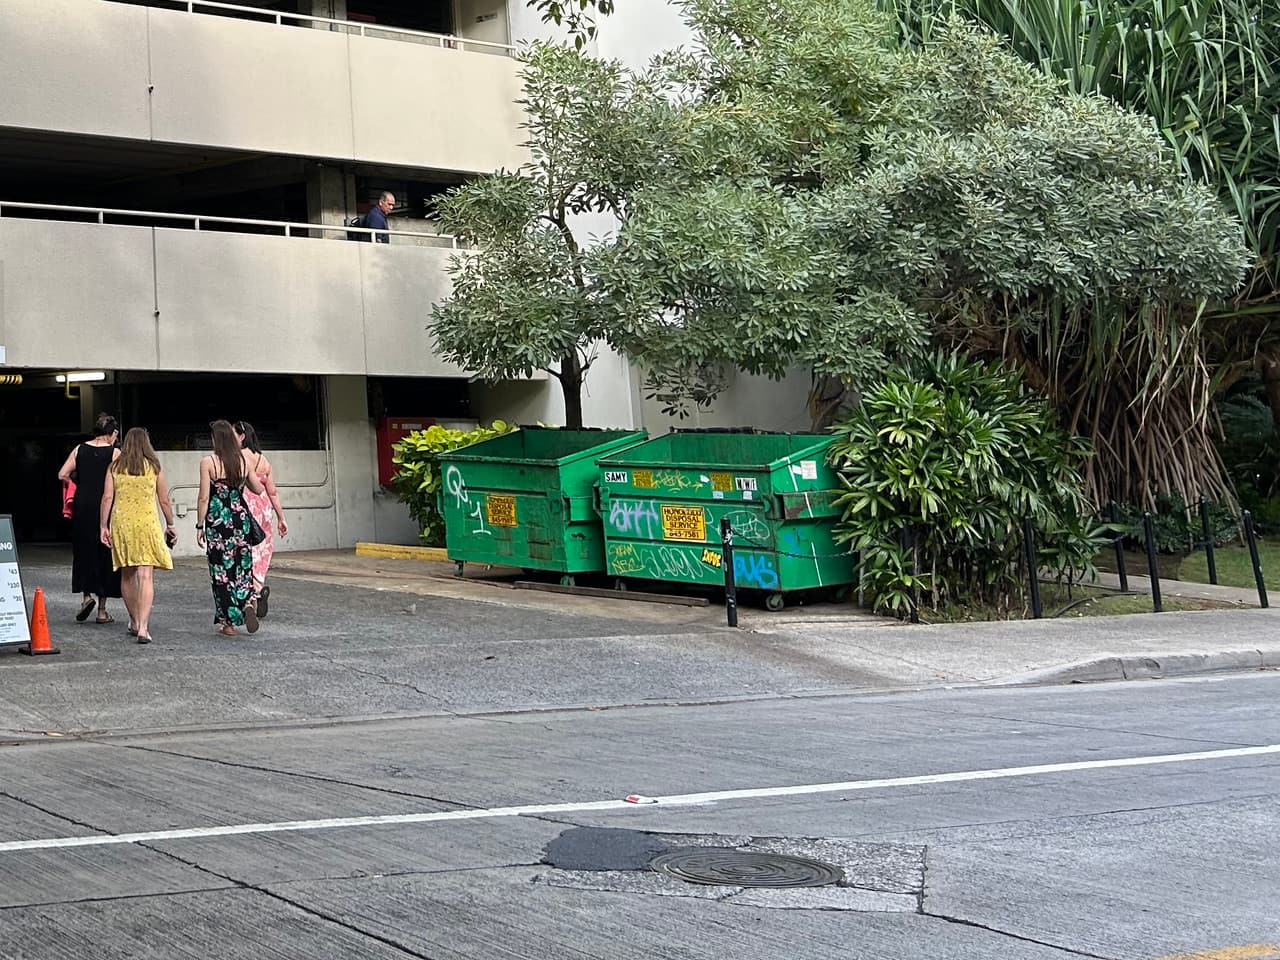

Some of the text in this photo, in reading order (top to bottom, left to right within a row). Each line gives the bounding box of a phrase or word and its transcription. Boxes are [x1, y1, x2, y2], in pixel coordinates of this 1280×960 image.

[605, 472, 627, 482] SAMY
[665, 515, 700, 523] DISPOSAL
[670, 521, 699, 529] SERVICE
